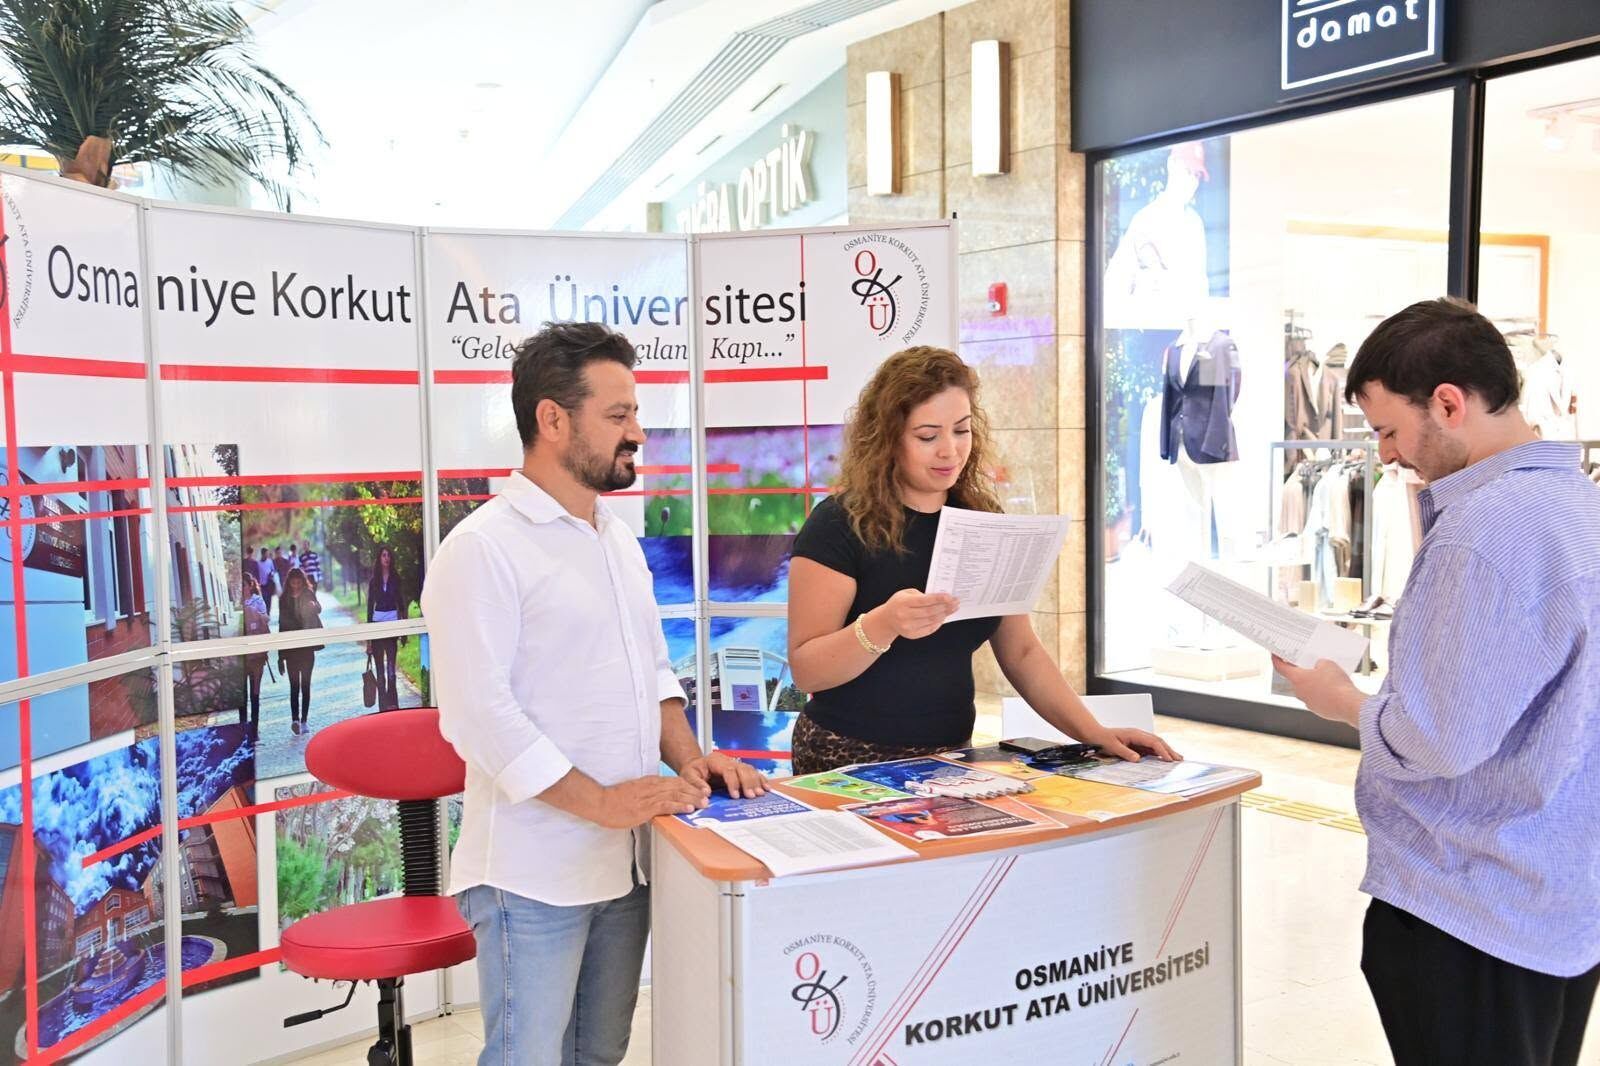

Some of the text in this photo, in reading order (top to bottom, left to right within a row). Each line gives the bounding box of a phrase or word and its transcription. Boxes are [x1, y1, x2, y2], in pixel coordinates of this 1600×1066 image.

[1296, 0, 1418, 48] damat
[738, 122, 812, 231] OPTİK
[843, 233, 888, 252] OSMANİYE
[888, 237, 919, 263] KORKUT
[914, 264, 927, 280] ATA
[272, 271, 412, 323] Korkut
[446, 281, 521, 324] Ata
[636, 337, 688, 365] çılan
[860, 961, 873, 980] ATA
[1015, 942, 1133, 990] OSMANİYE
[905, 941, 1210, 1045] KORKUT ATA ÜNİVERSİTESİ
